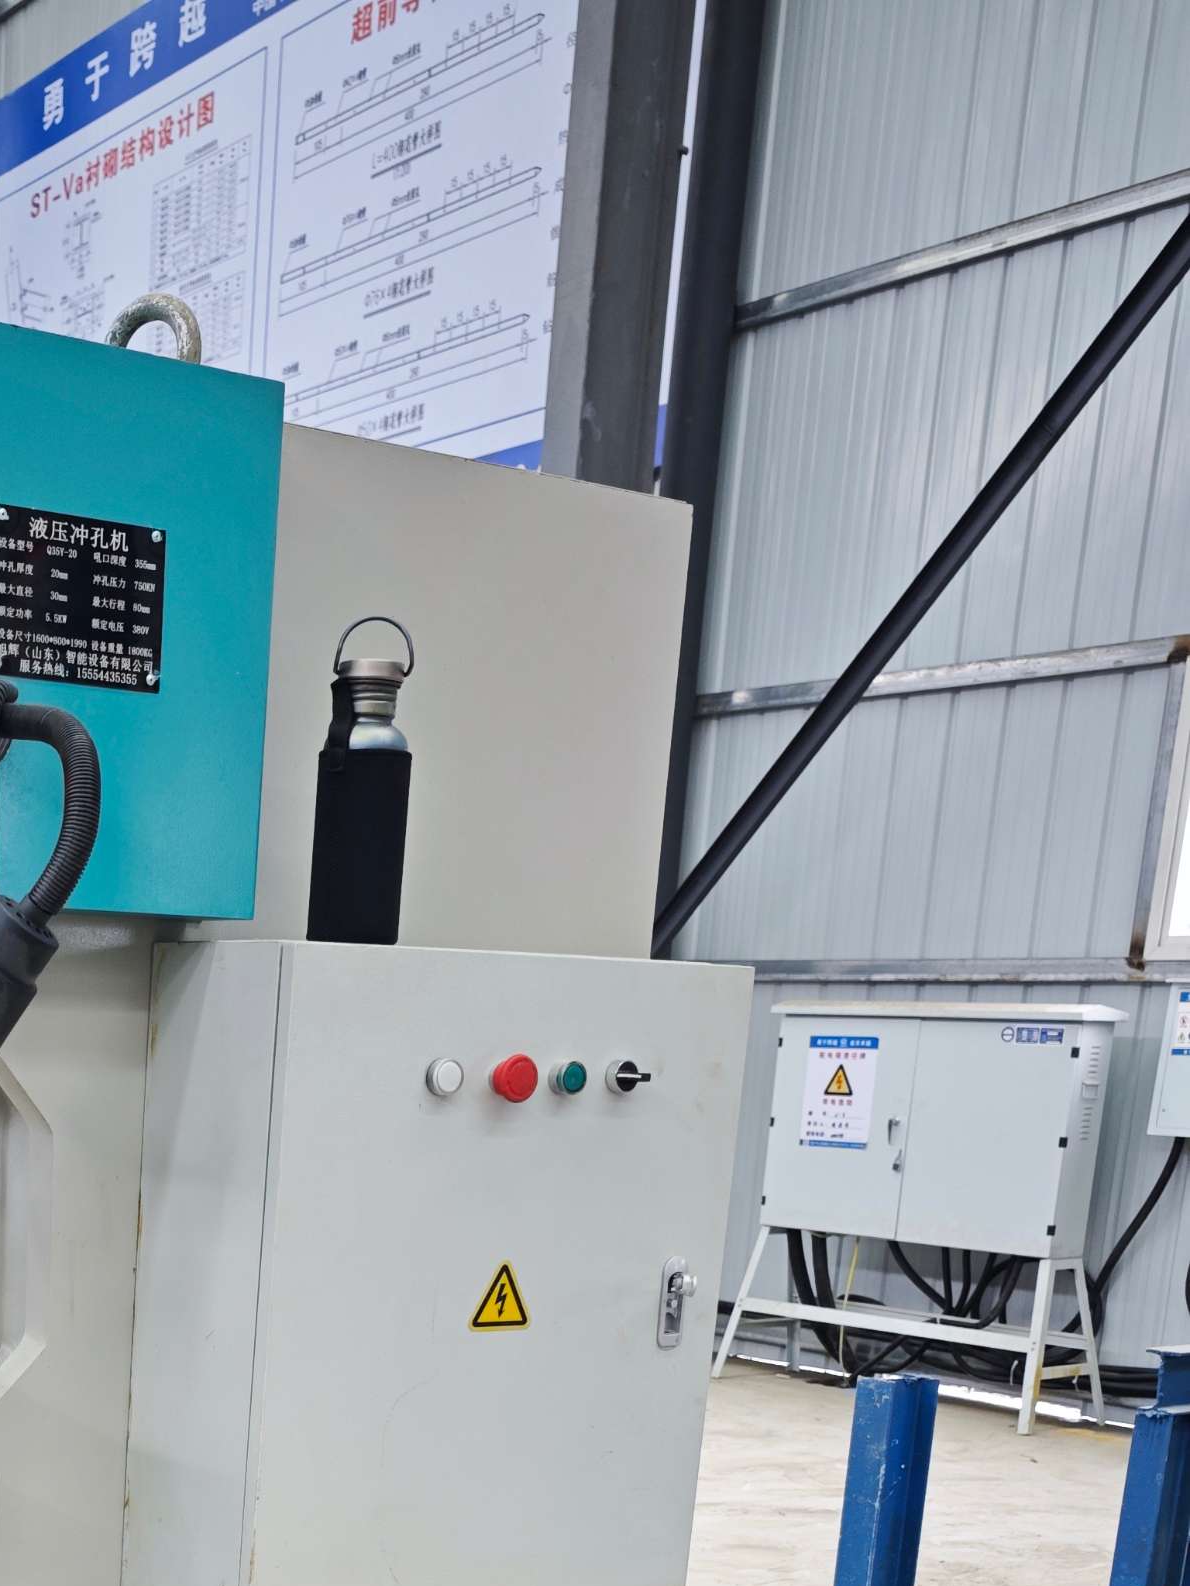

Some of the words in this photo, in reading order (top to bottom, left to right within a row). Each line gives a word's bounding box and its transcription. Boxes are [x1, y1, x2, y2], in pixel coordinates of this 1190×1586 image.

[42, 0, 208, 131] 勇于跨越
[30, 91, 215, 220] ST-Va衬砌结构设计图
[29, 516, 129, 552] 液压冲孔机
[0, 537, 34, 552] 设备型号
[46, 545, 78, 559] Q35Y-20
[50, 568, 68, 580] 20mm
[93, 574, 126, 589] 冲孔压力
[134, 581, 156, 592] 750KN
[50, 591, 68, 603] 30mm
[92, 596, 126, 611] 最大行程
[46, 613, 67, 624] 5.5KW
[92, 618, 124, 632] 额定电压
[132, 624, 150, 636] 380V
[92, 640, 124, 655] 设备重量
[76, 668, 138, 686] 15554435355
